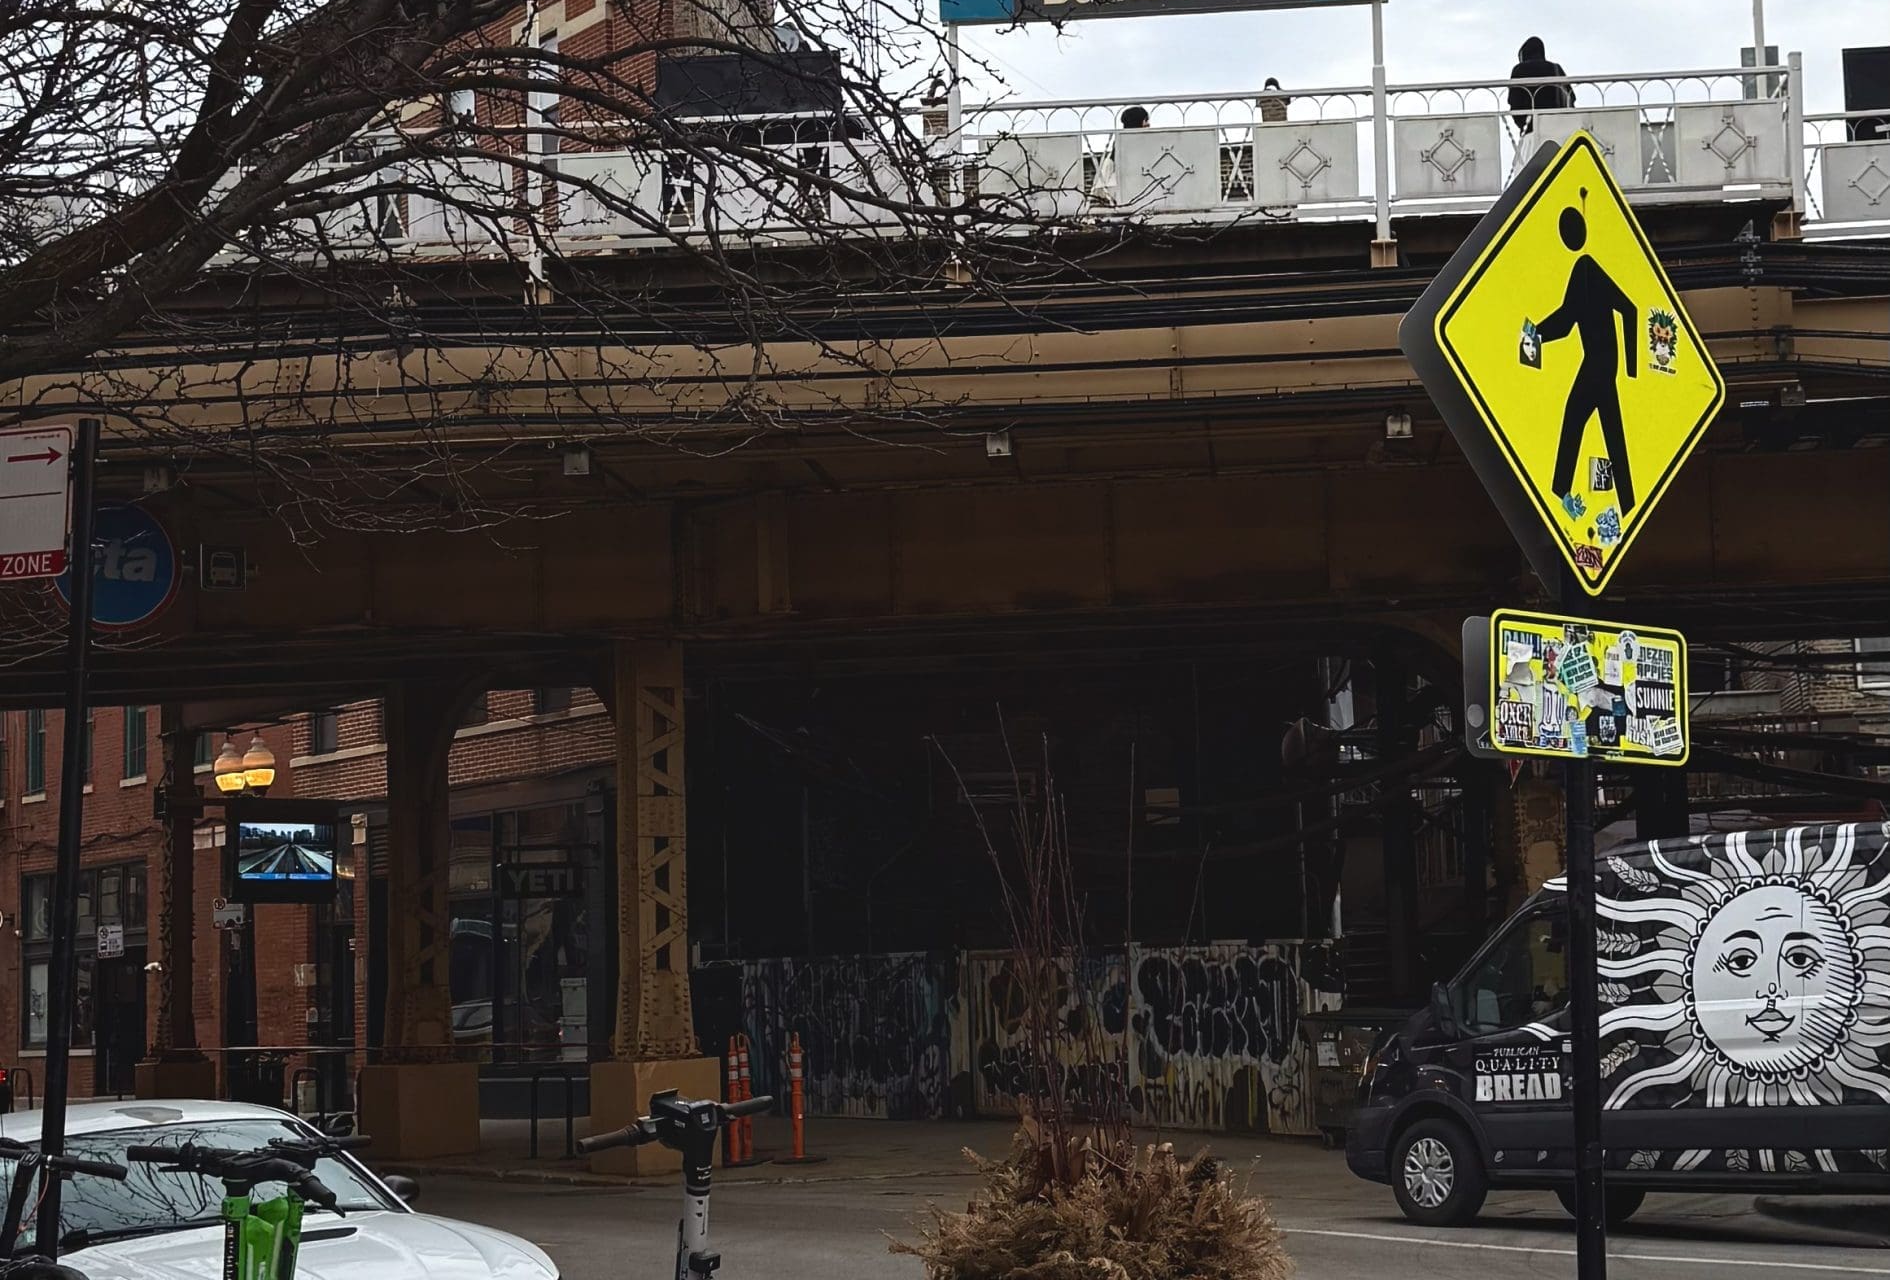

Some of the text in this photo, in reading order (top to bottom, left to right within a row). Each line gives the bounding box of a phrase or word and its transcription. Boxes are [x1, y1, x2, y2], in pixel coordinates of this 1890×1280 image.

[2, 553, 53, 576] ZONE
[95, 539, 157, 582] ta
[1637, 686, 1674, 711] SUNNIE
[507, 869, 575, 893] YETI
[1475, 1072, 1562, 1102] BREAD
